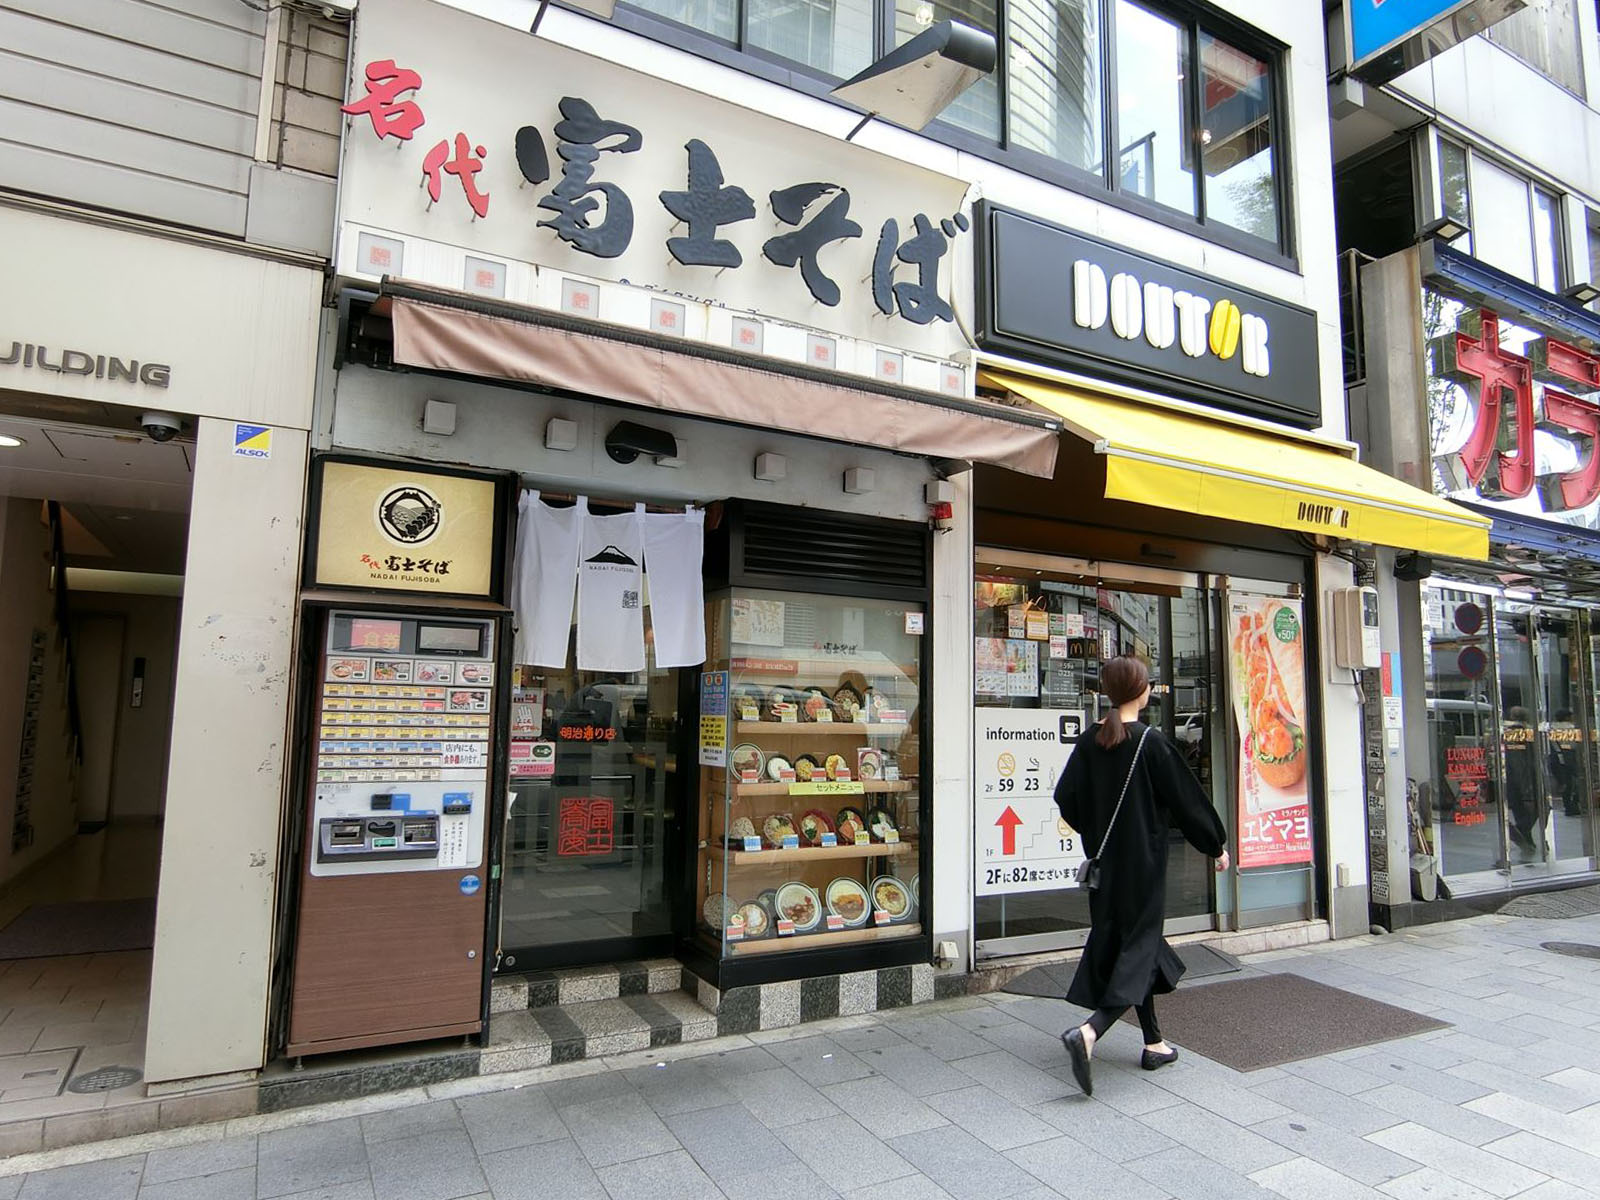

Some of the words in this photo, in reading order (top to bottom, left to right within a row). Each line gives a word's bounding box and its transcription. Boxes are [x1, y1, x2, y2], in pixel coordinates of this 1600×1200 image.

[341, 60, 490, 218] 名代
[515, 97, 969, 325] 富士そば
[1074, 259, 1270, 377] DOUTOR
[235, 448, 269, 458] ALSOK
[1297, 501, 1349, 528] DOUTOR
[385, 555, 453, 575] 富士そば
[401, 574, 440, 583] FUJISOBA
[560, 725, 617, 740] 明治通り店
[986, 727, 1055, 741] information
[816, 783, 862, 792] セットメニュー
[985, 784, 993, 792] 2F
[999, 779, 1014, 792] 59
[1024, 778, 1039, 791] 23
[1455, 811, 1486, 827] English
[1241, 812, 1309, 843] エビマヨ
[986, 849, 994, 857] 1F
[1059, 838, 1073, 852] 13
